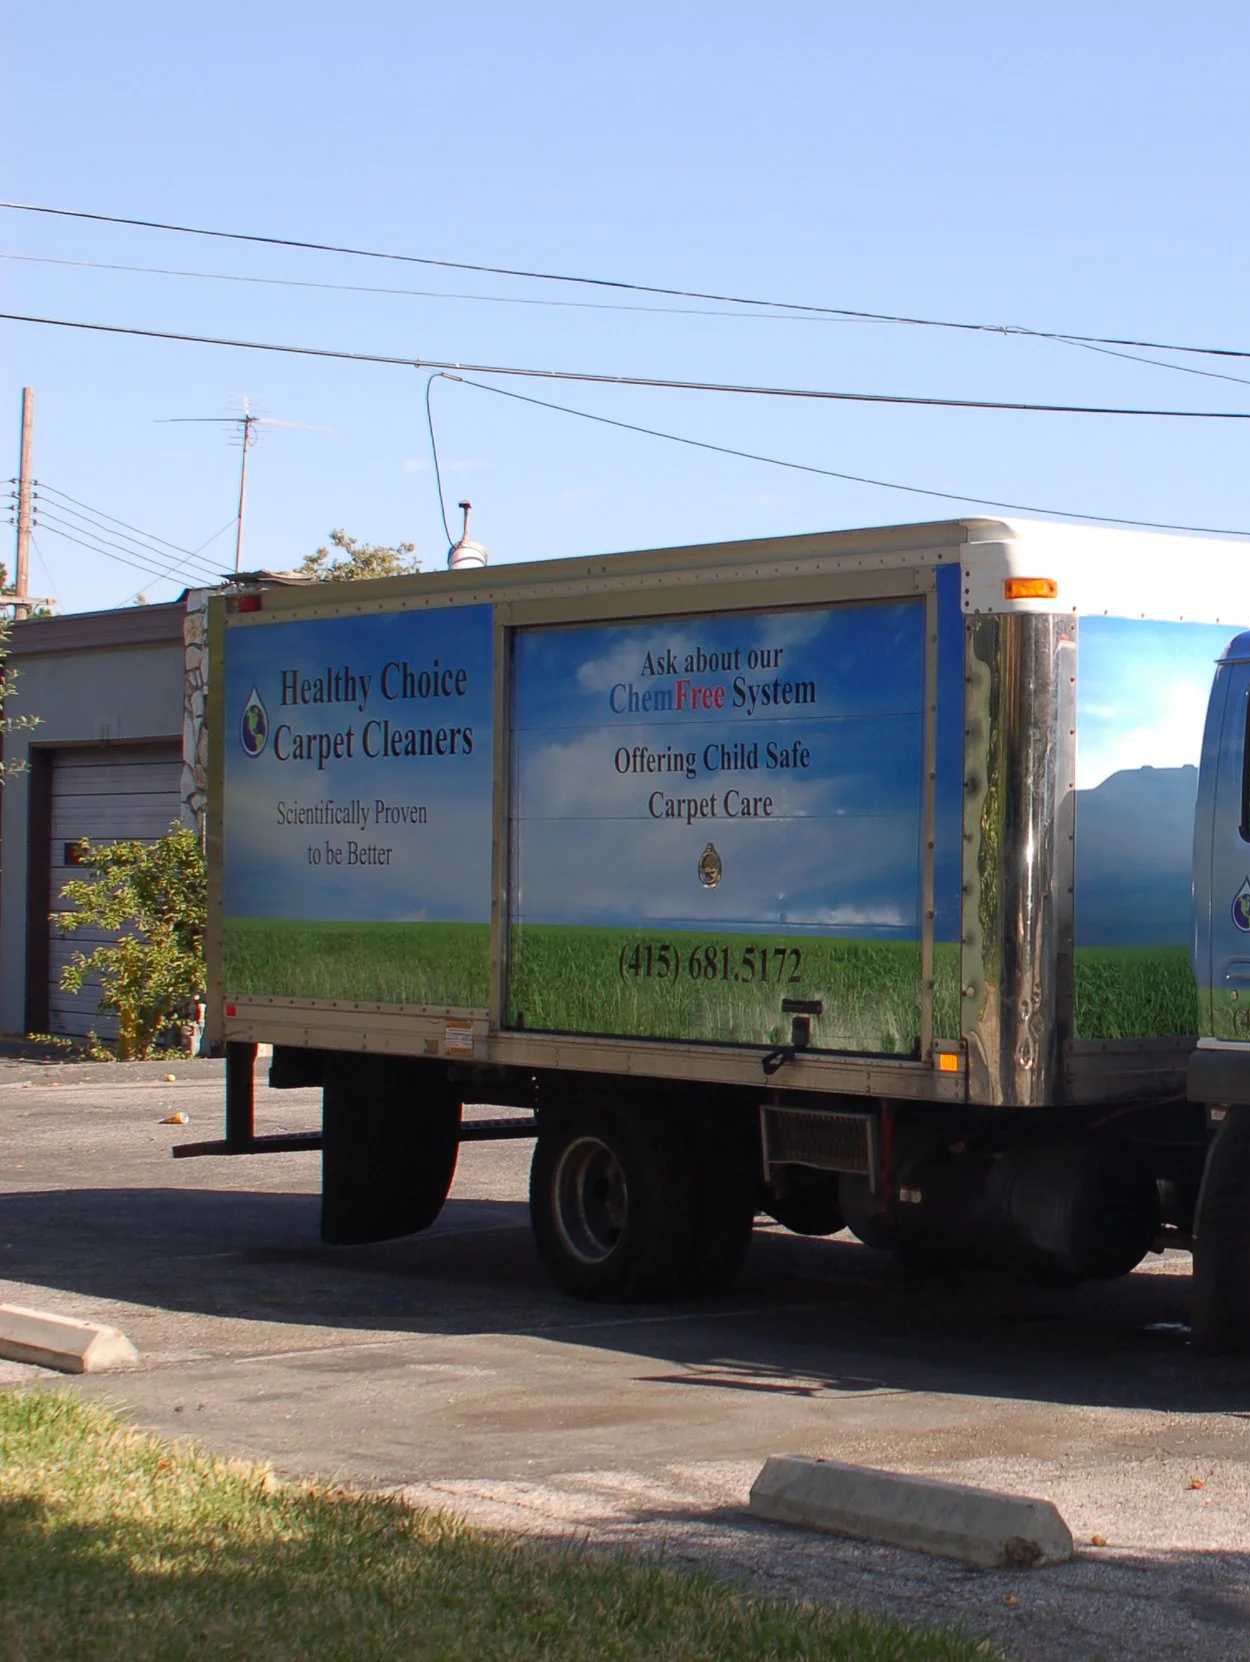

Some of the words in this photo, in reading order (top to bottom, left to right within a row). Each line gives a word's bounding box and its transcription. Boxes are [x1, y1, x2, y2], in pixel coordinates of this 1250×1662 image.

[641, 649, 678, 676] Ask
[684, 647, 741, 673] about
[747, 648, 783, 669] our
[280, 665, 372, 712] Healthy
[380, 658, 467, 700] Choice
[609, 679, 726, 714] ChemFree
[732, 676, 817, 715] System
[273, 724, 354, 770] Carpet
[362, 719, 474, 758] Cleaners
[614, 745, 697, 779] Offering
[703, 742, 758, 771] Child
[766, 740, 811, 769] Safe
[276, 800, 370, 831] Scientifically
[375, 800, 428, 824] Proven
[648, 791, 717, 825] Carpet
[723, 789, 773, 817] Care
[308, 845, 321, 866] to
[325, 841, 343, 865] be
[347, 841, 393, 866] Better
[618, 943, 681, 988] (415)
[688, 945, 803, 983] 681.5172
